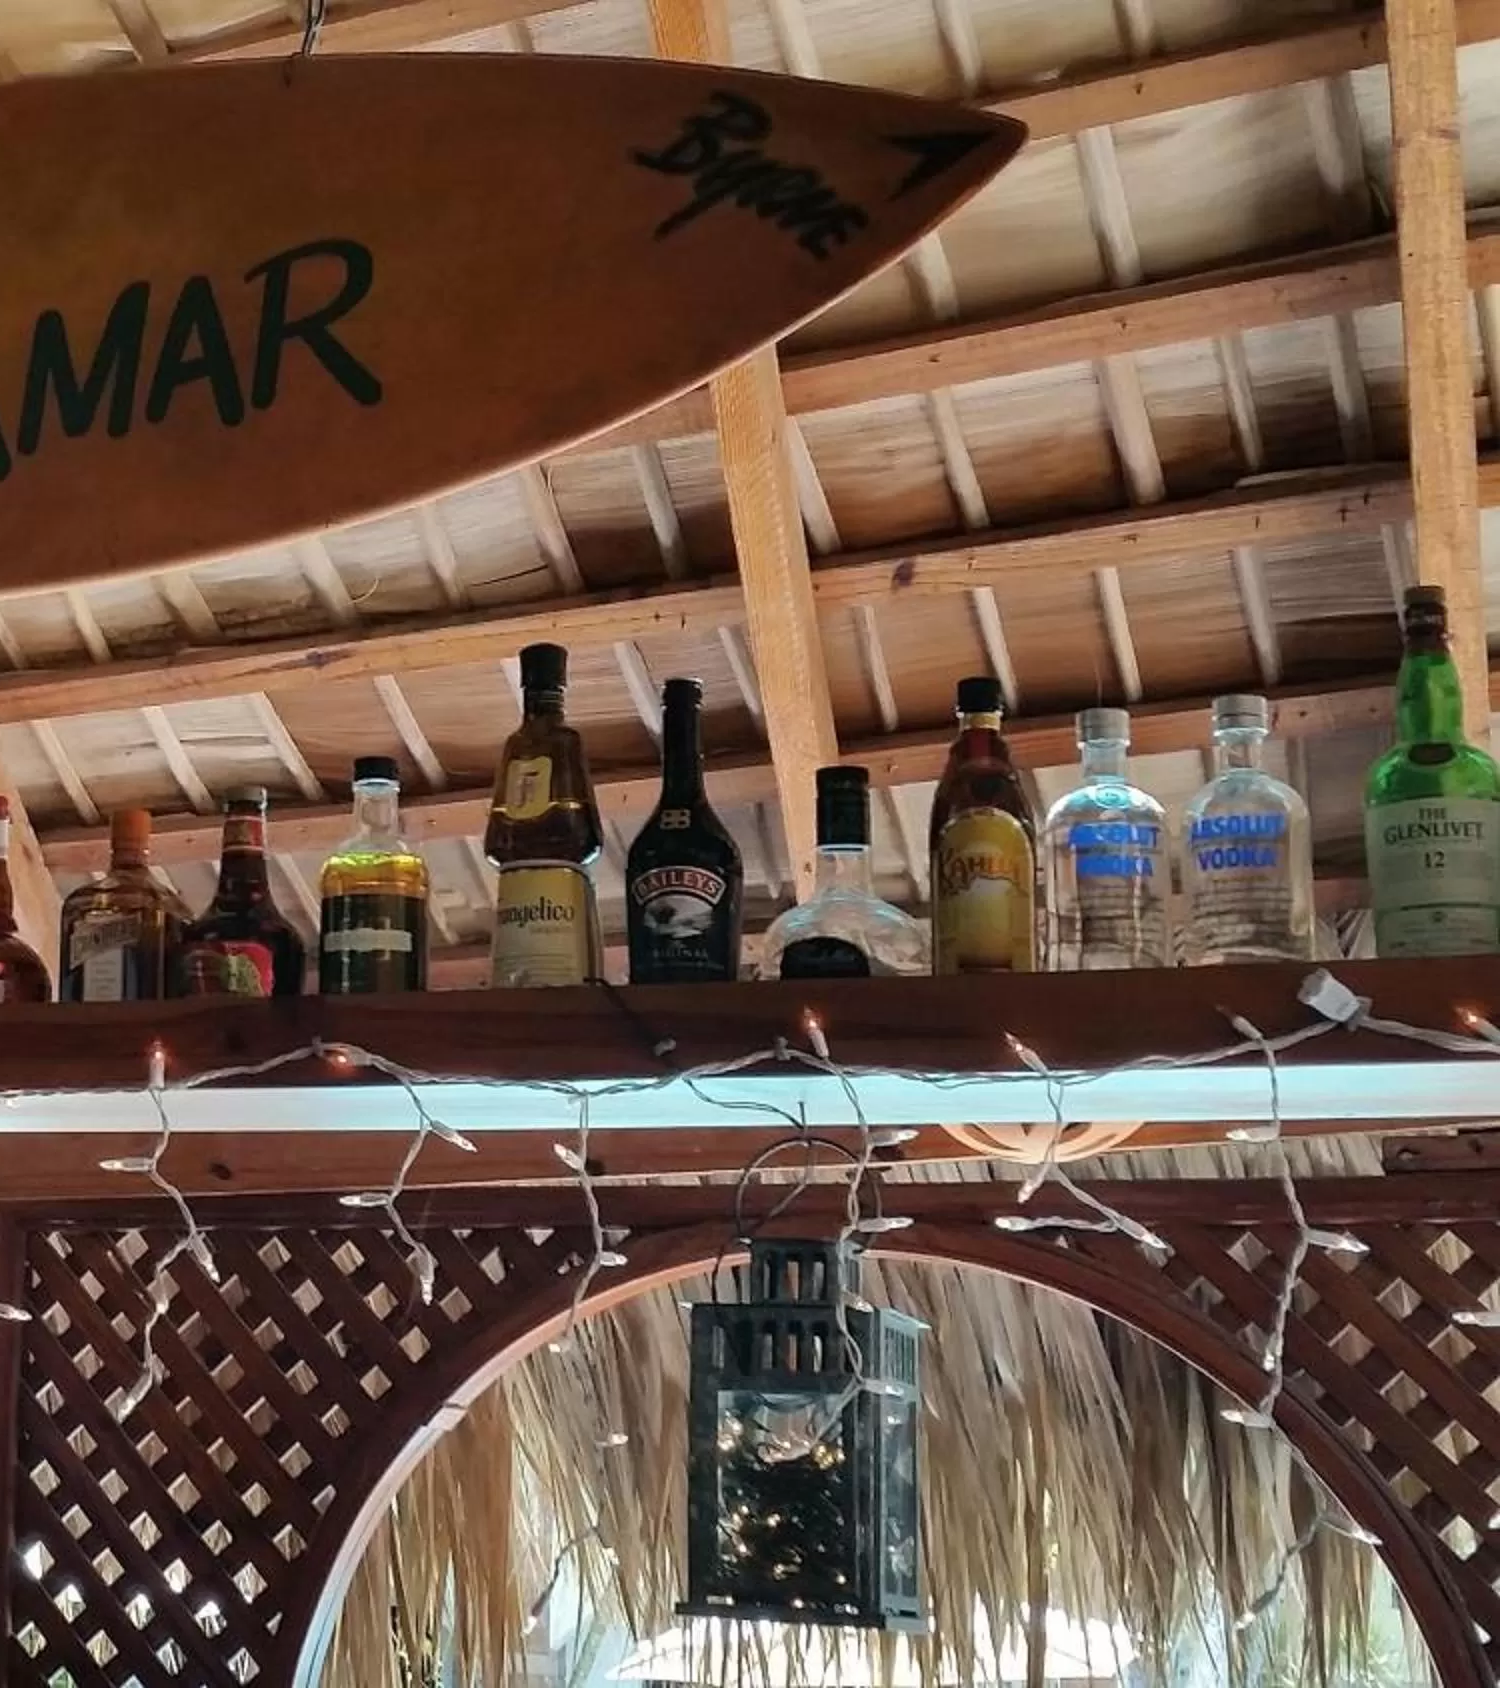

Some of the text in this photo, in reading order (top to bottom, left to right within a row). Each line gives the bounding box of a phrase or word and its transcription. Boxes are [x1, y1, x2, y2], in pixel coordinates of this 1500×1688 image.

[1418, 807, 1447, 820] THE
[1384, 820, 1484, 846] GLENLIVET
[1198, 846, 1277, 872] VODKA
[1424, 851, 1446, 869] 12
[637, 870, 721, 897] BAILEYS
[498, 896, 576, 927] angelico
